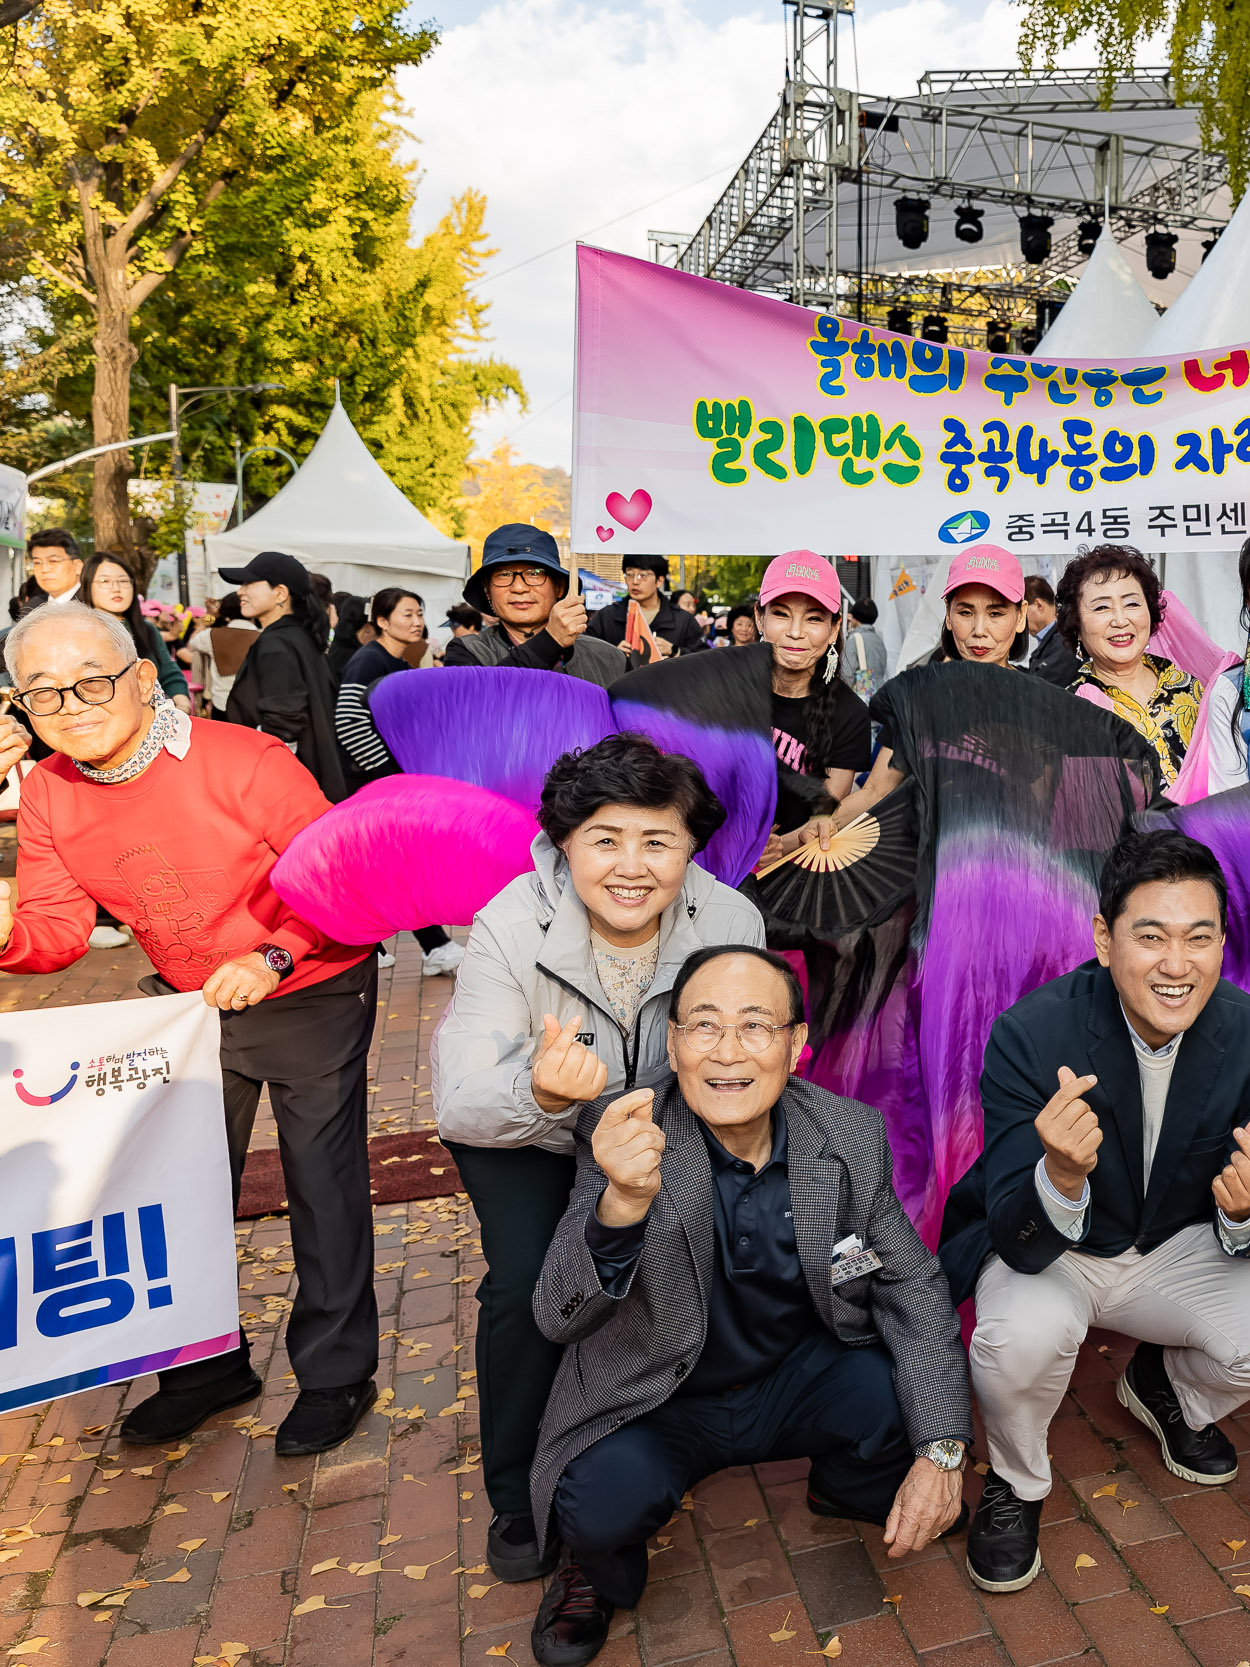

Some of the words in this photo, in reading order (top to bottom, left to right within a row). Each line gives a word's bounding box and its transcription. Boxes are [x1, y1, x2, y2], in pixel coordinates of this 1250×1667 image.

[807, 314, 968, 398] 올해의
[693, 396, 924, 487] 밸리댄스
[939, 417, 1157, 494] 중곡4동의
[1005, 506, 1131, 542] 중곡4동
[87, 1054, 125, 1072] 소통하며
[126, 1047, 168, 1067] 발전하는
[85, 1061, 171, 1096] 행복광진
